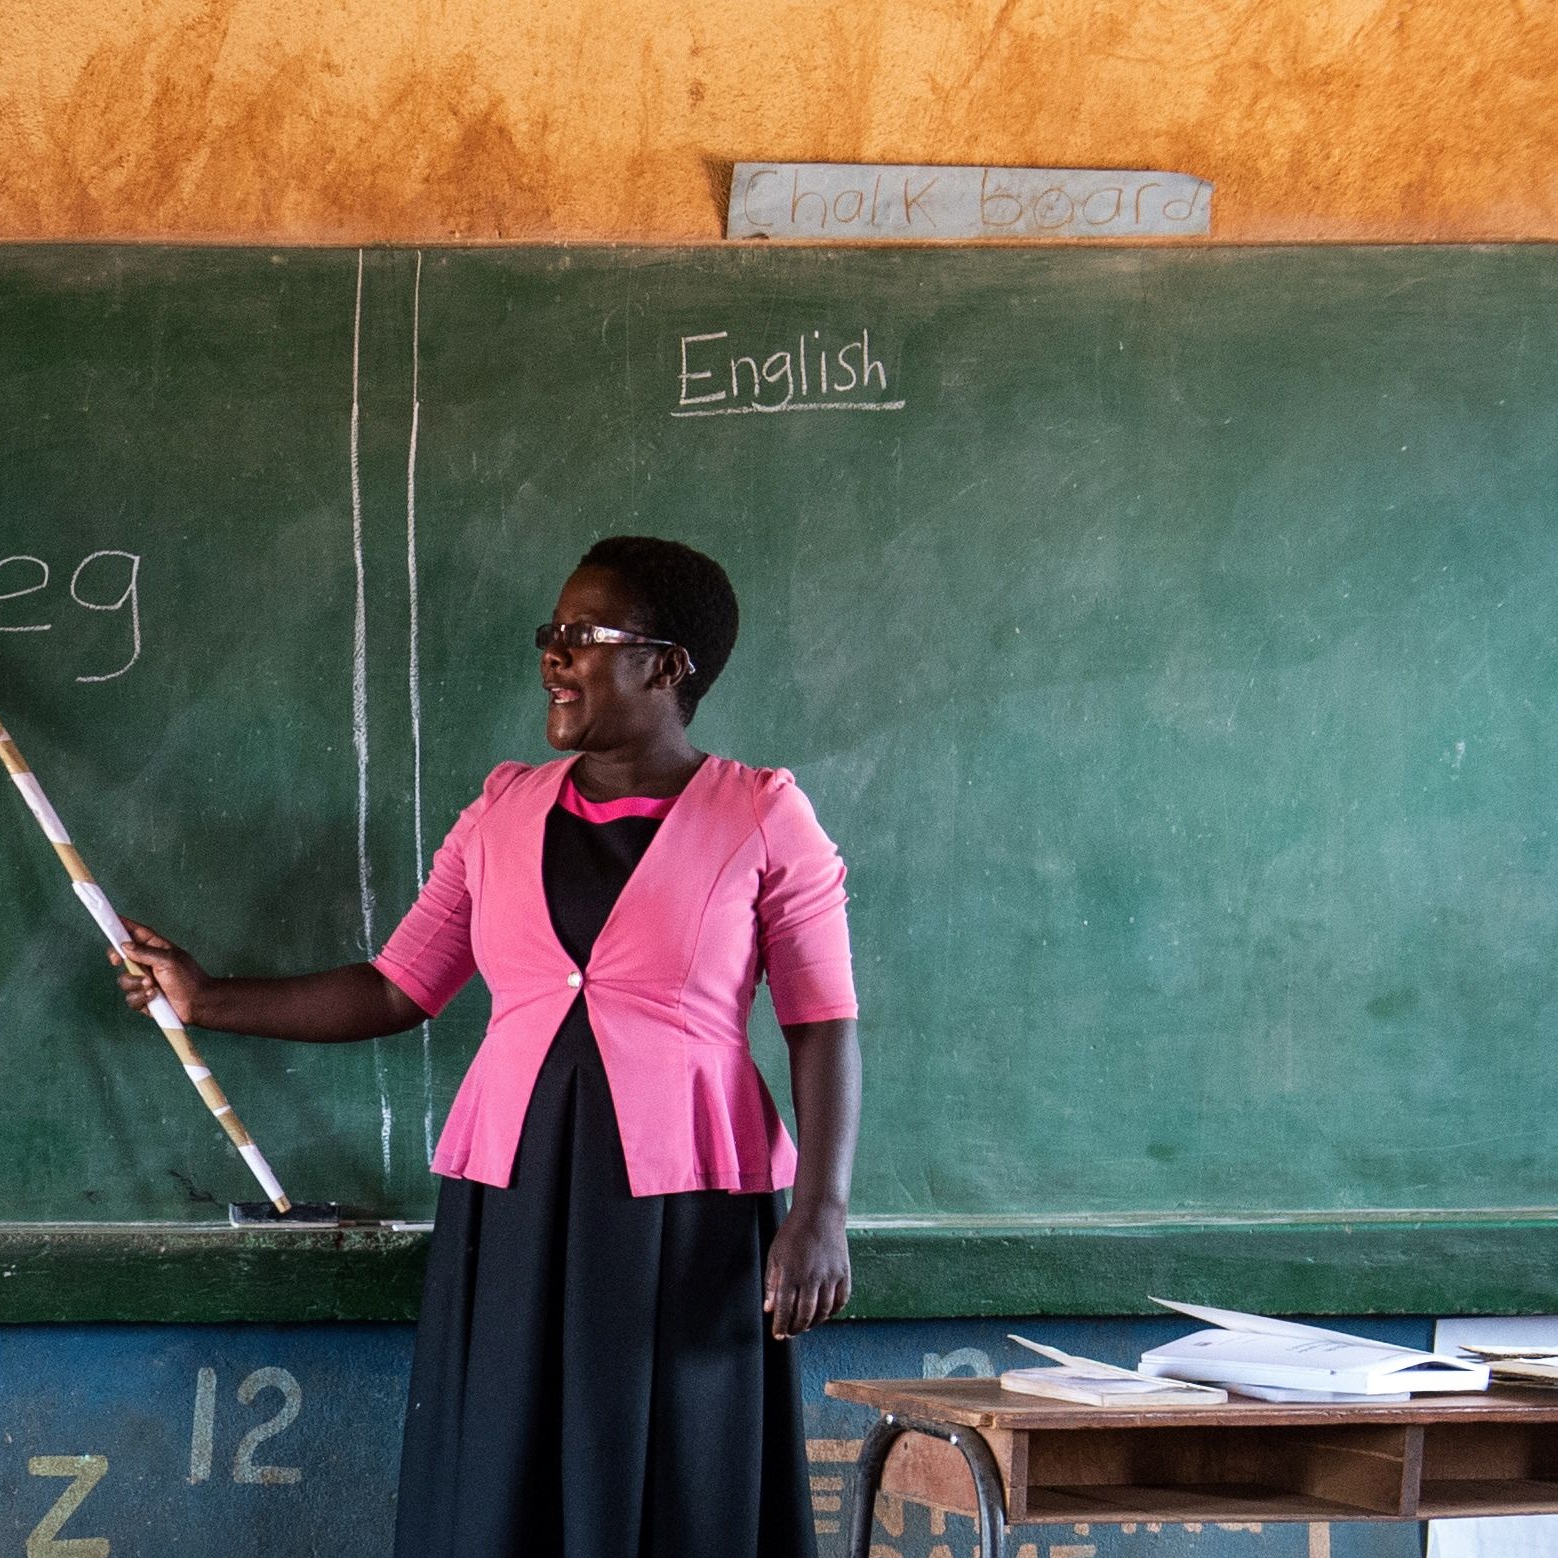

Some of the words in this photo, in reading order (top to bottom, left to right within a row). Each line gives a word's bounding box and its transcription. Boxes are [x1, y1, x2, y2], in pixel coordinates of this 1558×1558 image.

[979, 169, 1201, 230] board
[678, 328, 888, 412] English
[185, 1365, 304, 1486] 12
